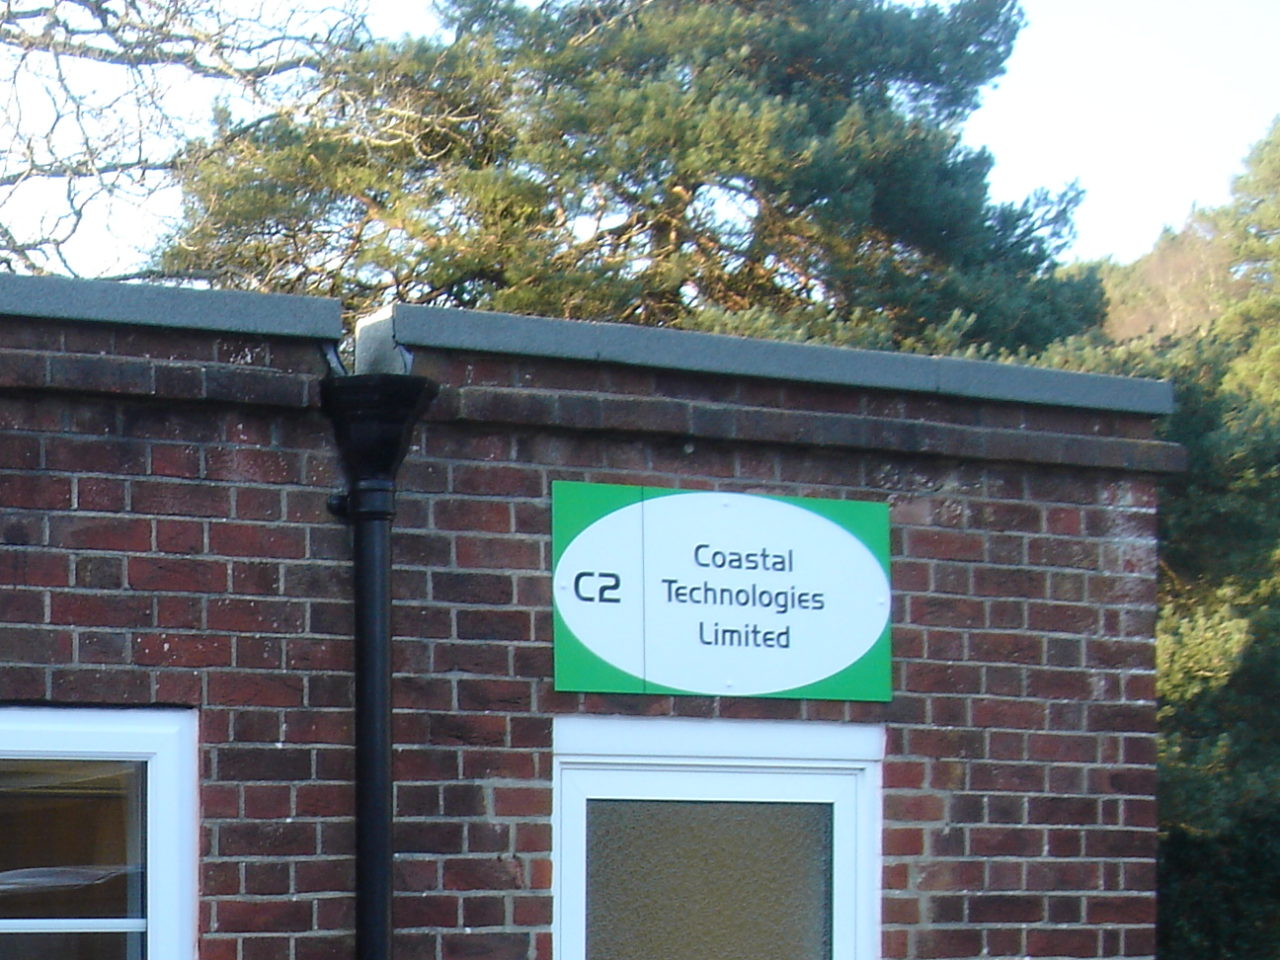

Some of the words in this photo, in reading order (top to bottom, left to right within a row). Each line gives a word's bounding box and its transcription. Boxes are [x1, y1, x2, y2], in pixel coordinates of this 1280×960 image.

[694, 544, 793, 572] Coastal
[574, 572, 621, 603] C2
[662, 579, 825, 614] Technologies
[699, 622, 790, 648] Limited
